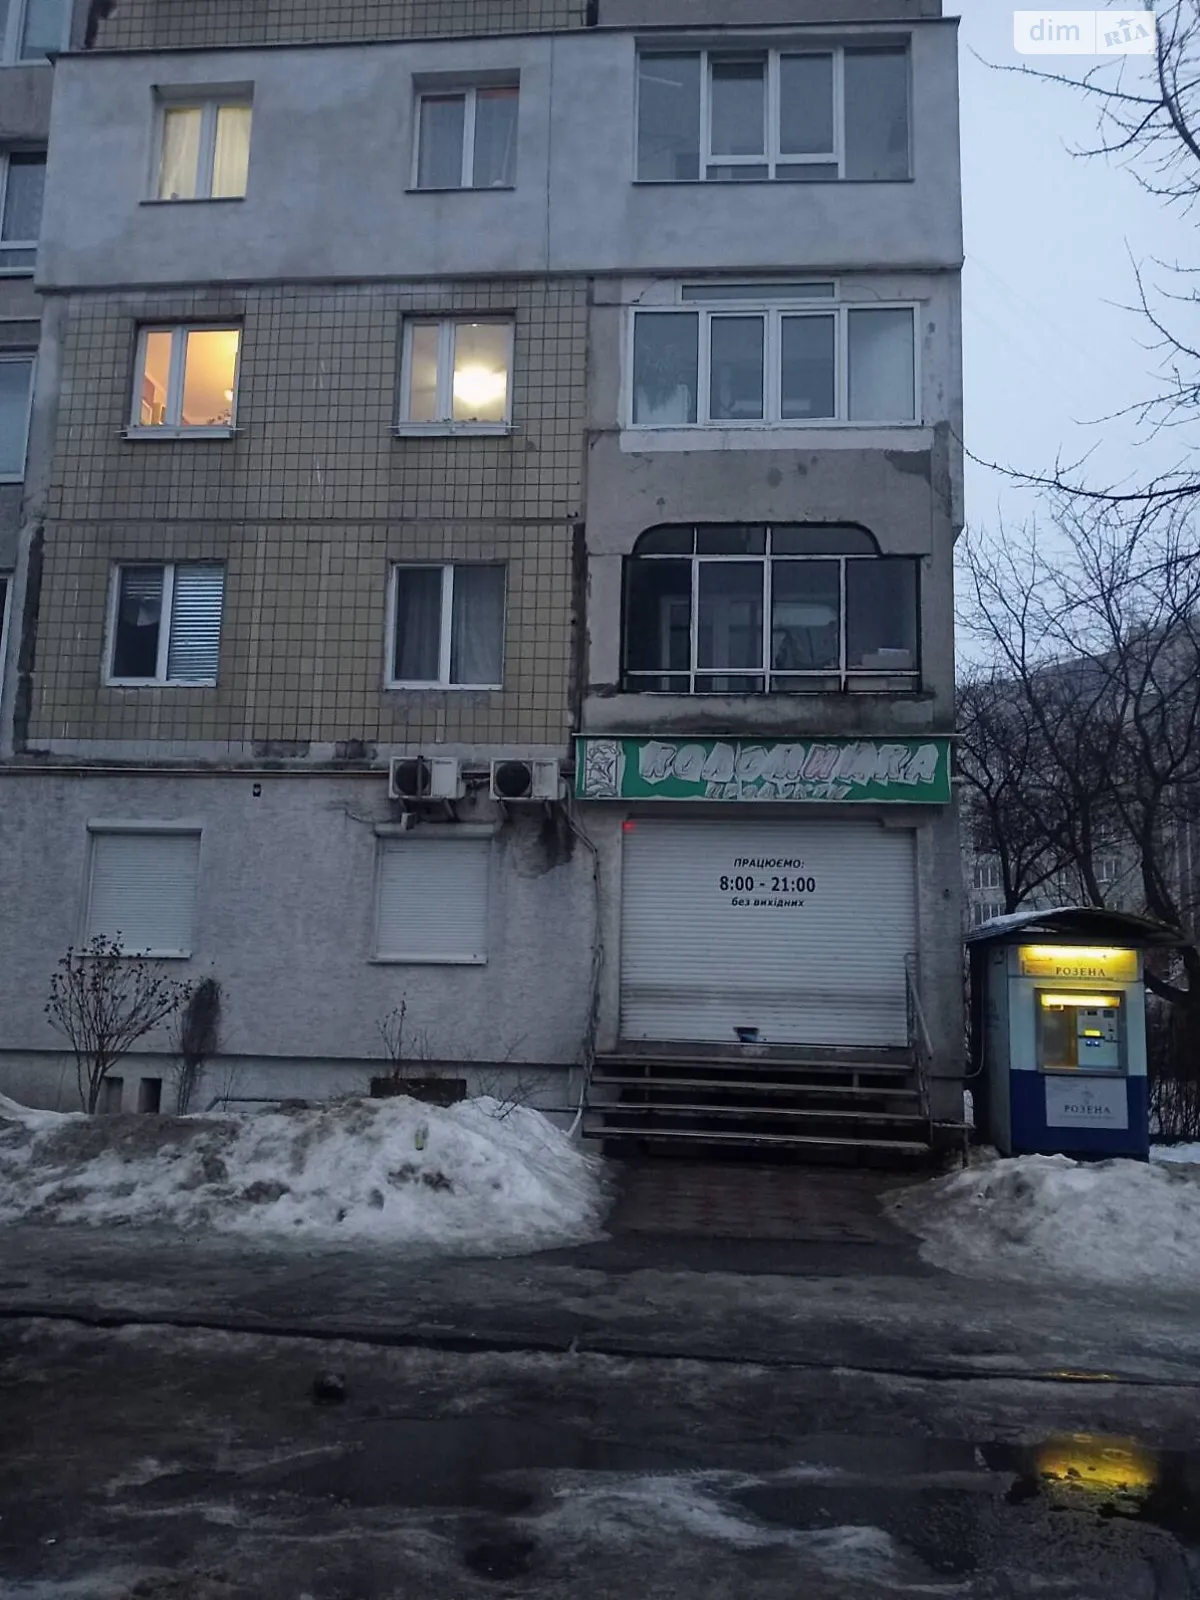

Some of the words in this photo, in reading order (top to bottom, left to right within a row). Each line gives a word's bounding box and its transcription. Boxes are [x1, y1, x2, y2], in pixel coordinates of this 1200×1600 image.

[733, 858, 805, 869] ПРАЦЮЄМО:
[719, 875, 754, 891] 8:00
[771, 876, 816, 893] 21:00
[731, 897, 750, 906] без
[753, 898, 804, 908] вихідних
[1055, 966, 1106, 977] РОЗЕНА
[1063, 1104, 1112, 1115] РОЗЕНА
